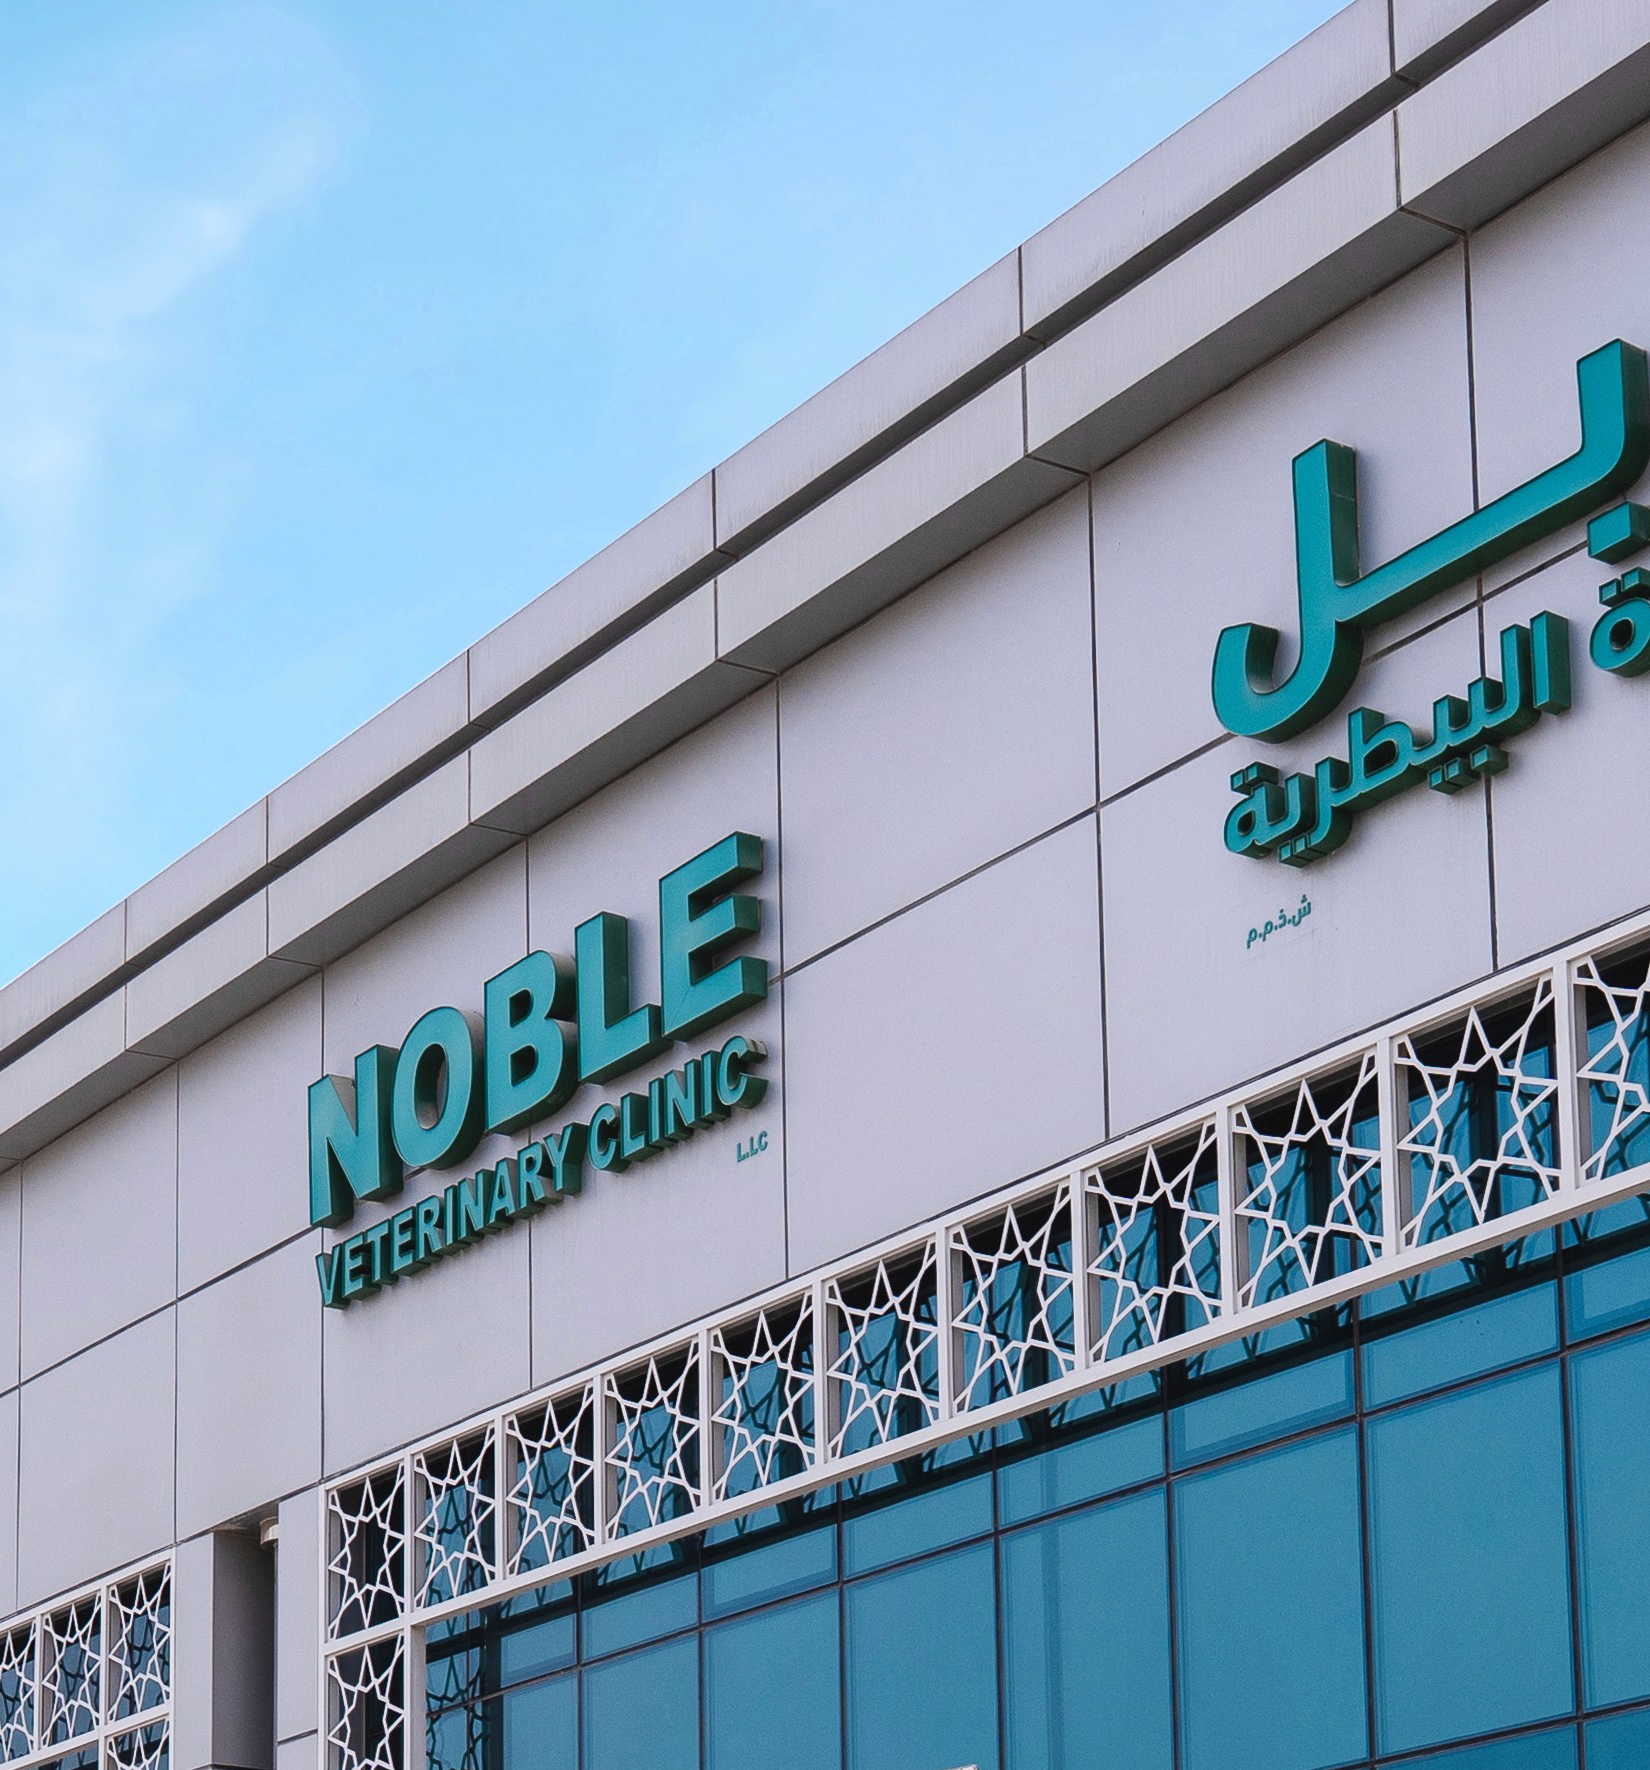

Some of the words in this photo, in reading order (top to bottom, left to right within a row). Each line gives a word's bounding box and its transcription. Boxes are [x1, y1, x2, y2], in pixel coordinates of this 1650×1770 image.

[1223, 611, 1571, 868] البيطرية
[307, 830, 768, 1228] NOBLE
[315, 1122, 592, 1310] VETERINARY
[587, 1035, 768, 1174] CLINIC
